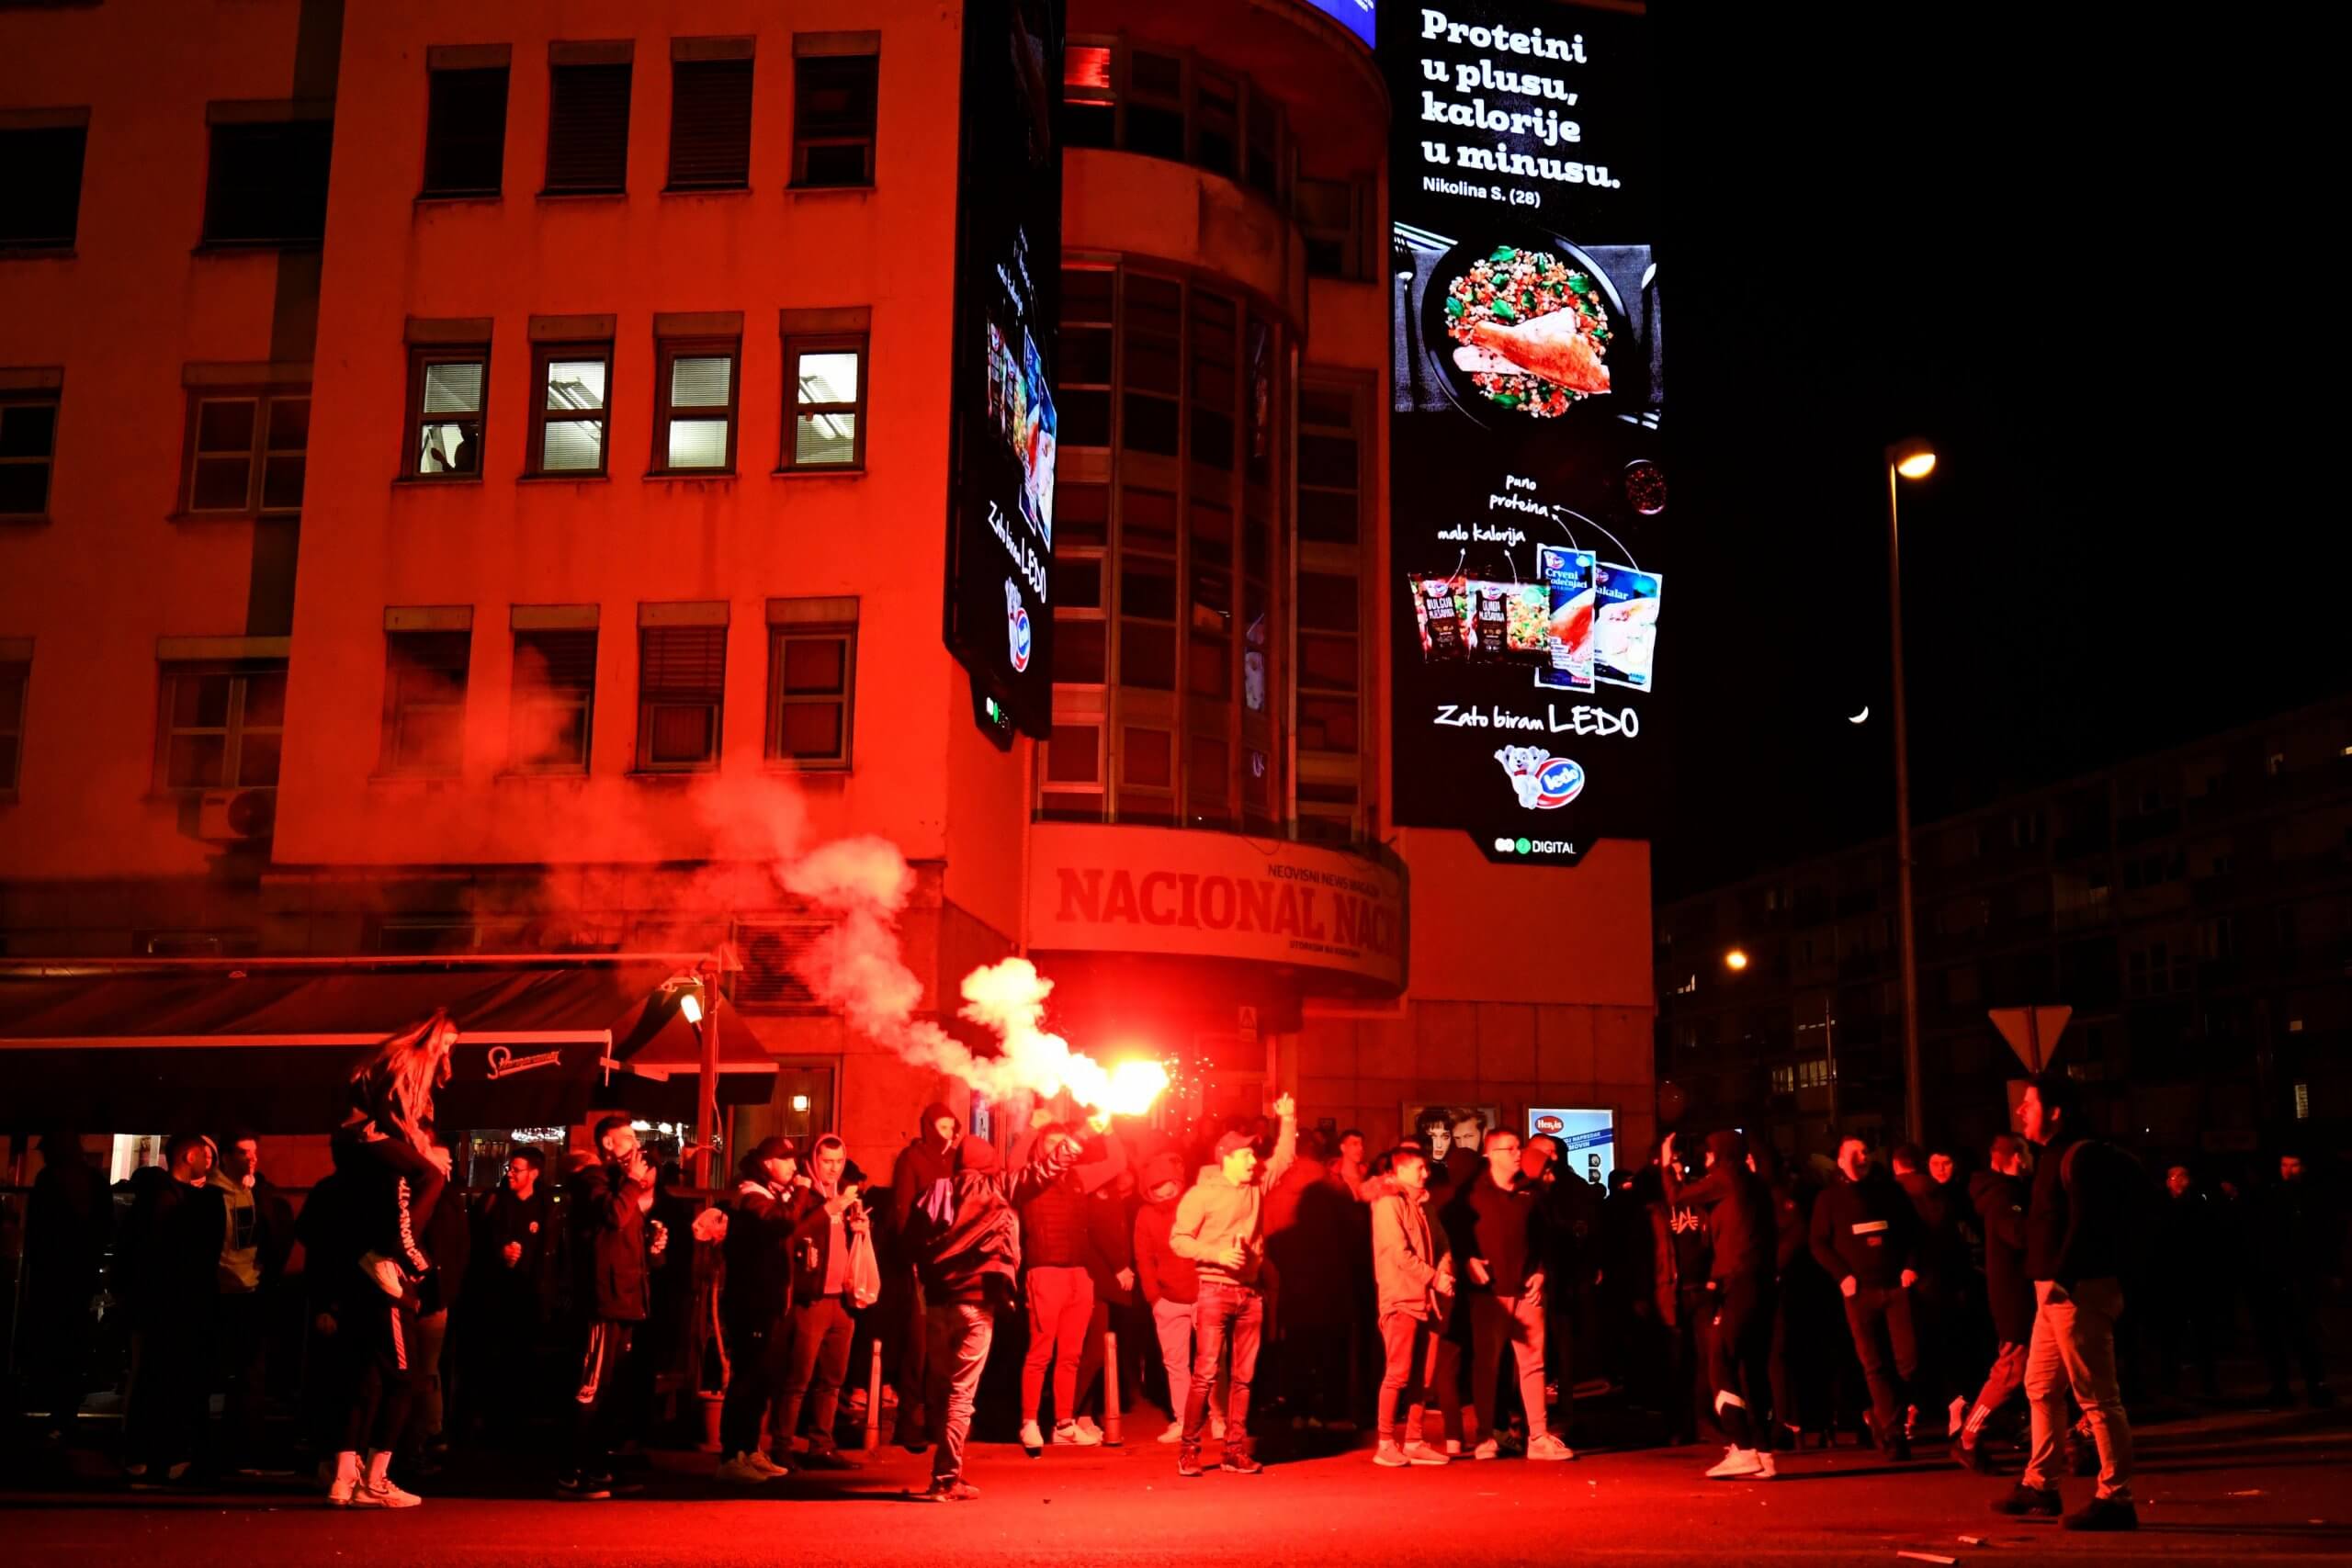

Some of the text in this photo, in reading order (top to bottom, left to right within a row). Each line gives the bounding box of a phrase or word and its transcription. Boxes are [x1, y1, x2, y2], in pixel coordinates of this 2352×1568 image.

[1421, 8, 1587, 63] Proteini
[1421, 59, 1577, 107] u plusu,
[1421, 90, 1580, 147] kalorije
[1421, 141, 1621, 189] u minusu.
[1423, 176, 1541, 209] Nikolina S. (28)
[1506, 474, 1537, 491] puno
[1489, 493, 1549, 517] proteina
[1437, 522, 1526, 547] malo kalorija
[1022, 536, 1046, 604] LEDO
[1545, 568, 1578, 581] Crveni
[1595, 586, 1629, 600] akalar
[1433, 704, 1639, 738] Zato biram LEDO
[1544, 767, 1579, 790] ledo
[1532, 840, 1577, 854] DIGITAL
[1268, 863, 1320, 884] NEOVISNI
[1321, 873, 1349, 890] NEWS
[1056, 866, 1326, 940] NACIONAL
[1536, 1119, 1562, 1131] Hervis
